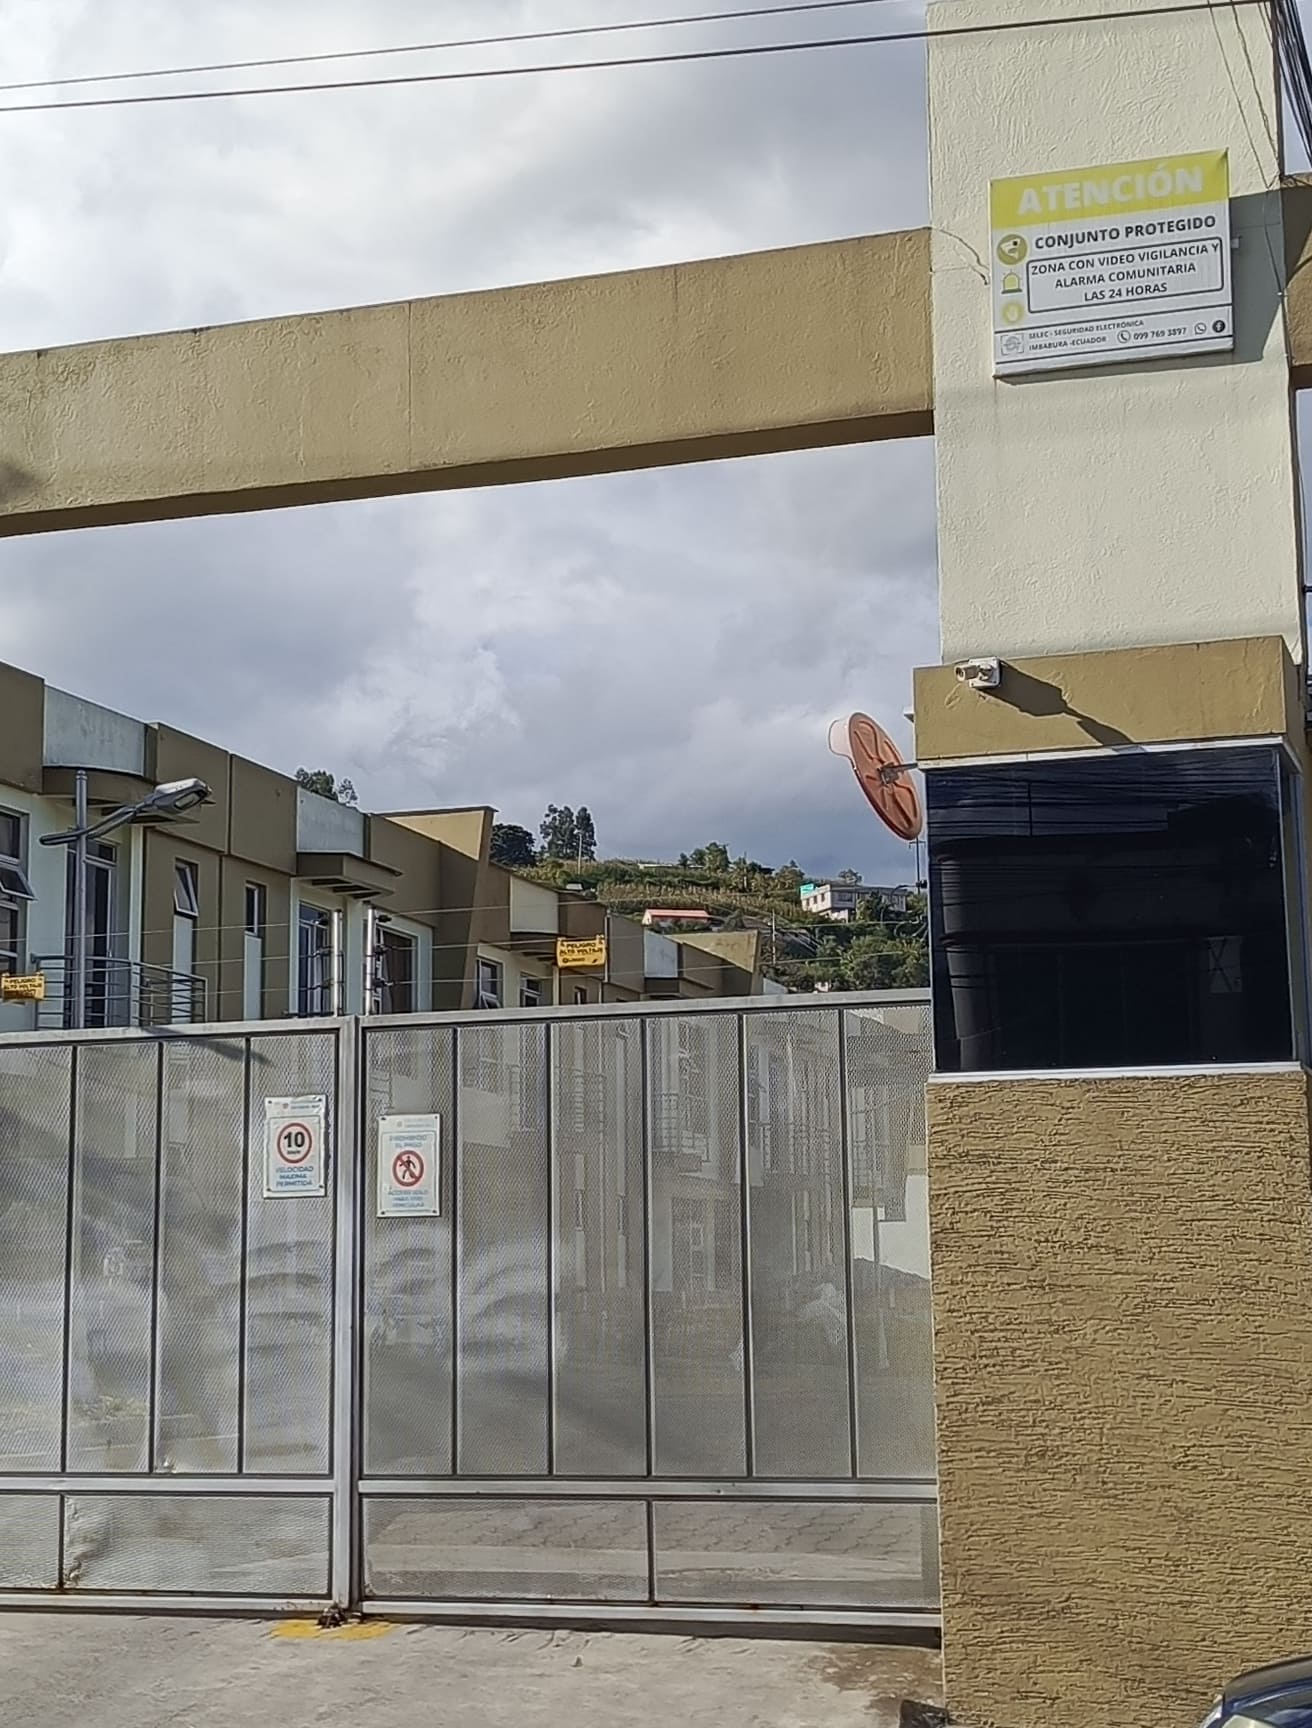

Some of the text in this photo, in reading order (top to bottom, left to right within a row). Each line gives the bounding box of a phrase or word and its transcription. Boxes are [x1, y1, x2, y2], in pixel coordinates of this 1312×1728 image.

[1019, 164, 1202, 214] ATENCIÓN
[1035, 215, 1216, 249] CONJUNTO PROTEGIDO
[1031, 243, 1220, 275] ZONA CON VIDEO VIGILANCIA Y
[1055, 262, 1196, 289] ALARMA COMUNITARIA
[1084, 283, 1167, 302] LAS 24 HORAS
[1054, 325, 1094, 336] SEGURIDAD
[1096, 319, 1144, 331] ELECTRÓNICA
[1029, 341, 1068, 351] IMBABURA
[284, 1131, 305, 1148] 10
